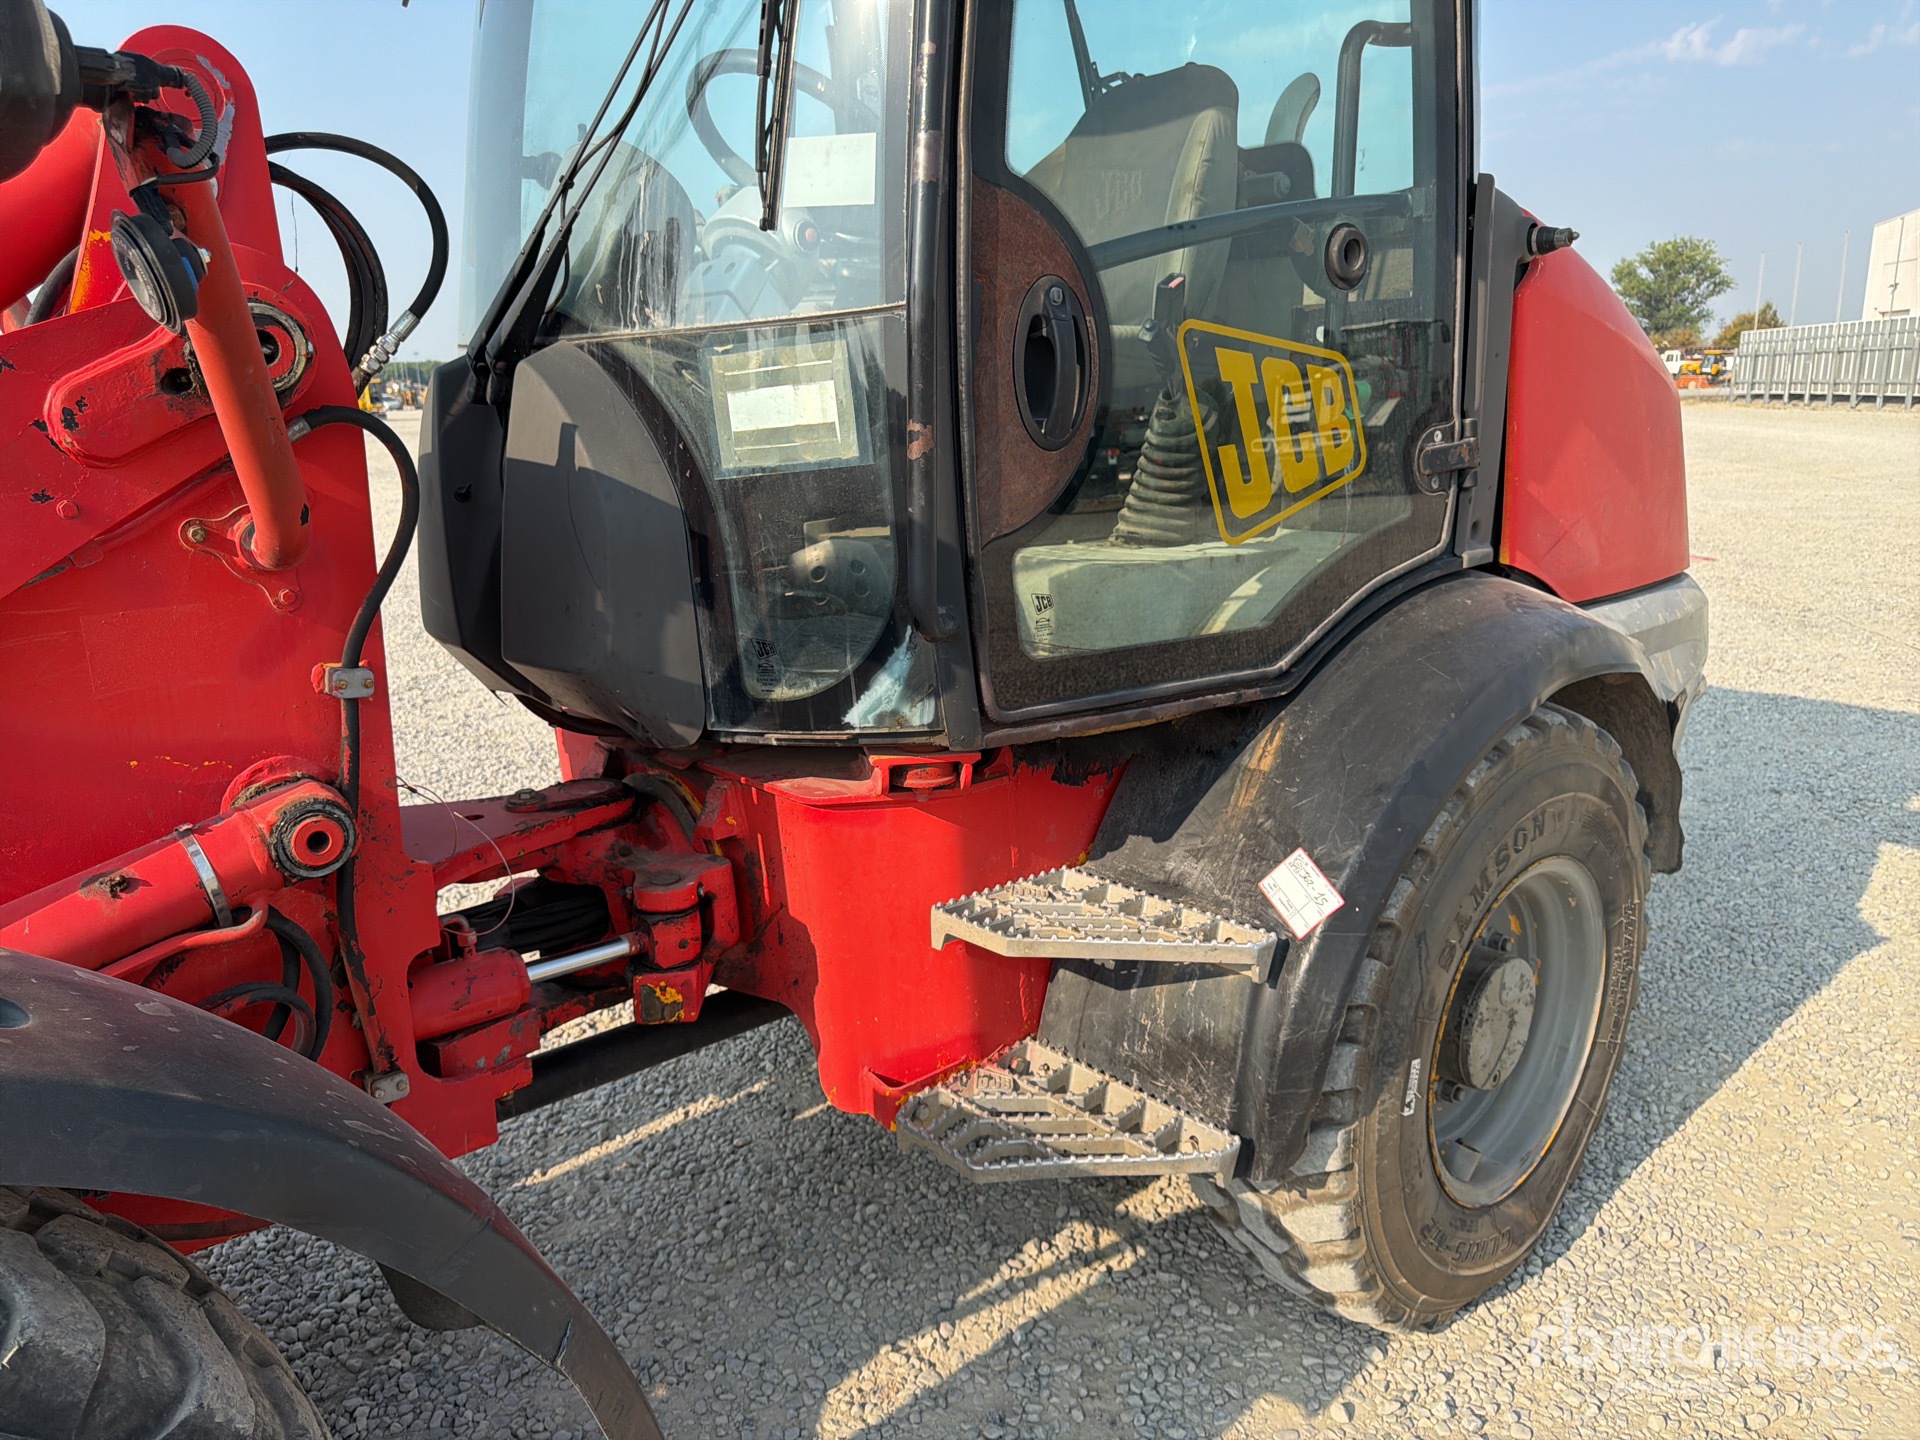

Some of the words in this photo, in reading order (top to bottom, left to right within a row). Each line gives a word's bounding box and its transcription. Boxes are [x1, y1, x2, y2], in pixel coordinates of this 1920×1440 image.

[1214, 346, 1354, 519] JCB
[1034, 595, 1053, 612] JCB
[755, 640, 776, 658] JCB
[1438, 811, 1547, 973] SAMSON
[978, 1073, 1012, 1089] JCB
